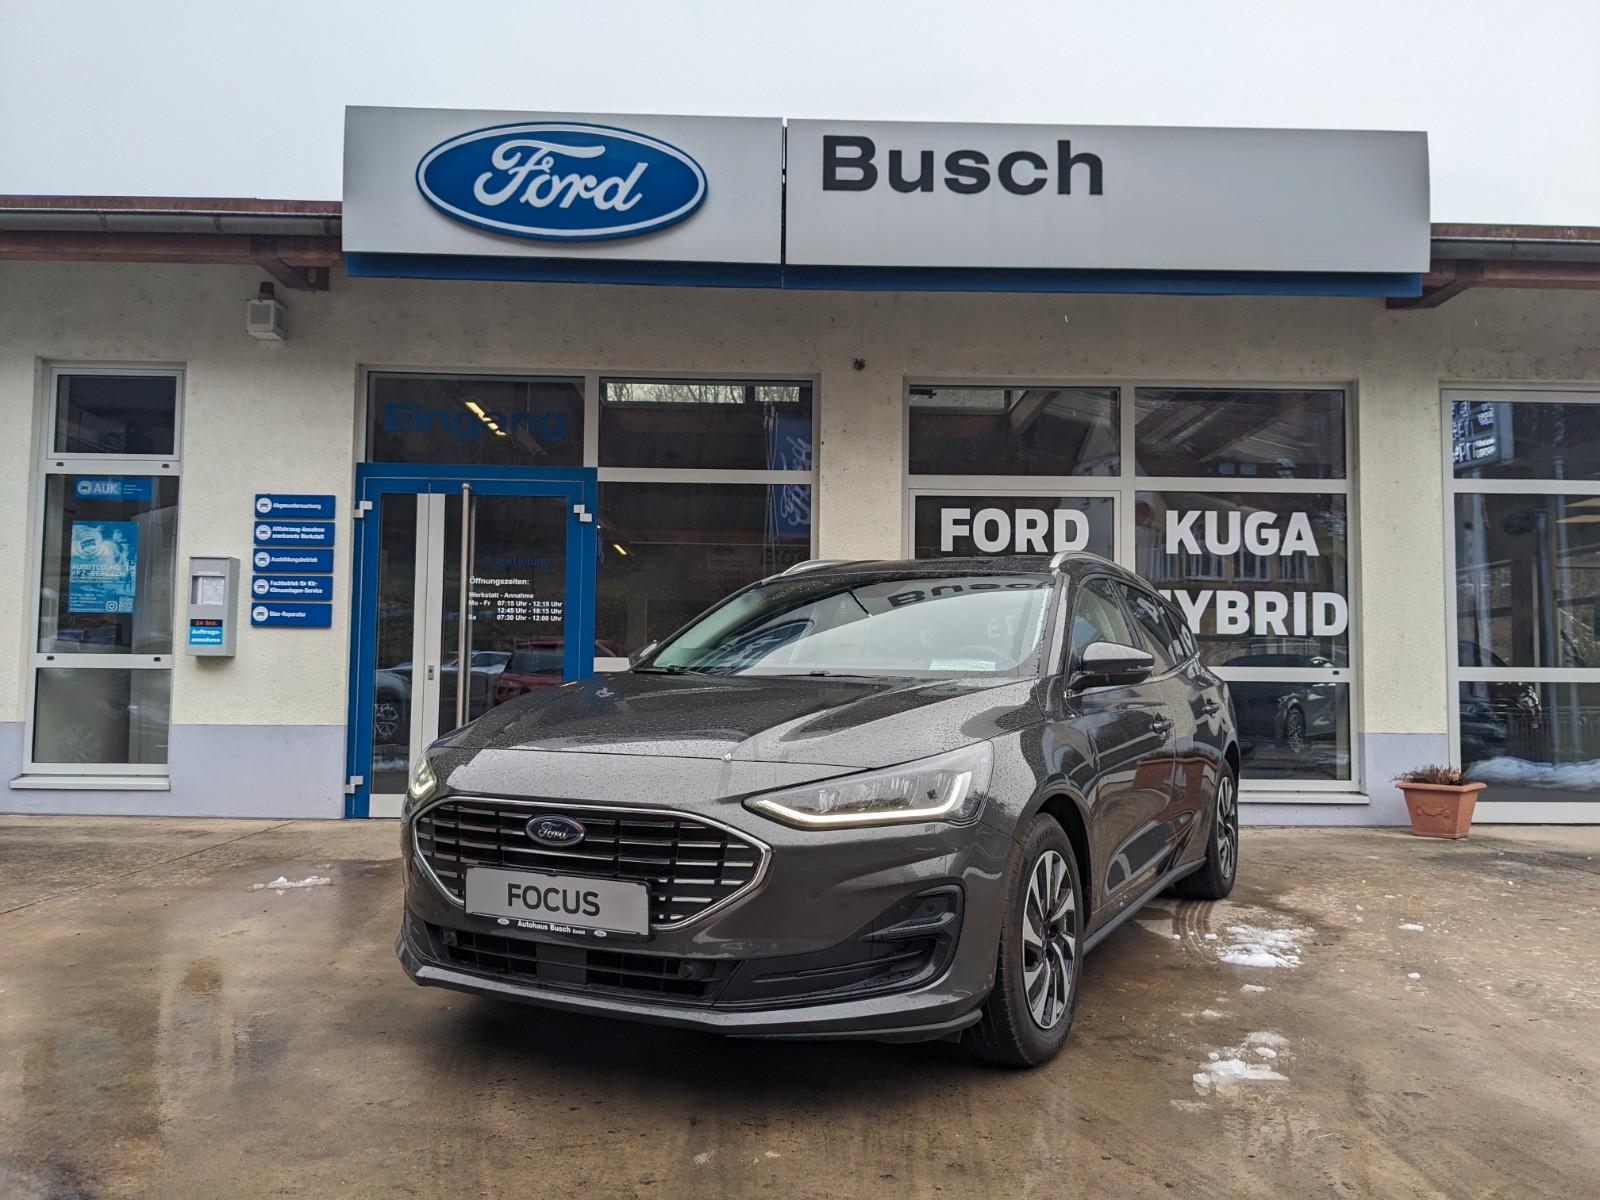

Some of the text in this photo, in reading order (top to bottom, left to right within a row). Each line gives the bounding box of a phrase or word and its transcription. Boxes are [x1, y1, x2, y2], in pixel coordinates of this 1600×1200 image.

[473, 139, 649, 212] Ford
[822, 135, 1104, 196] Busch
[383, 402, 567, 443] Eingang
[93, 482, 118, 495] AUK
[940, 508, 1090, 553] FORD
[1165, 510, 1320, 557] KUGA
[469, 576, 530, 586] Öffnungszeiten:
[1158, 589, 1348, 637] YBRID
[537, 821, 569, 839] Ford
[507, 883, 600, 917] FOCUS
[517, 920, 549, 931] Autohaus
[549, 924, 571, 934] Busch
